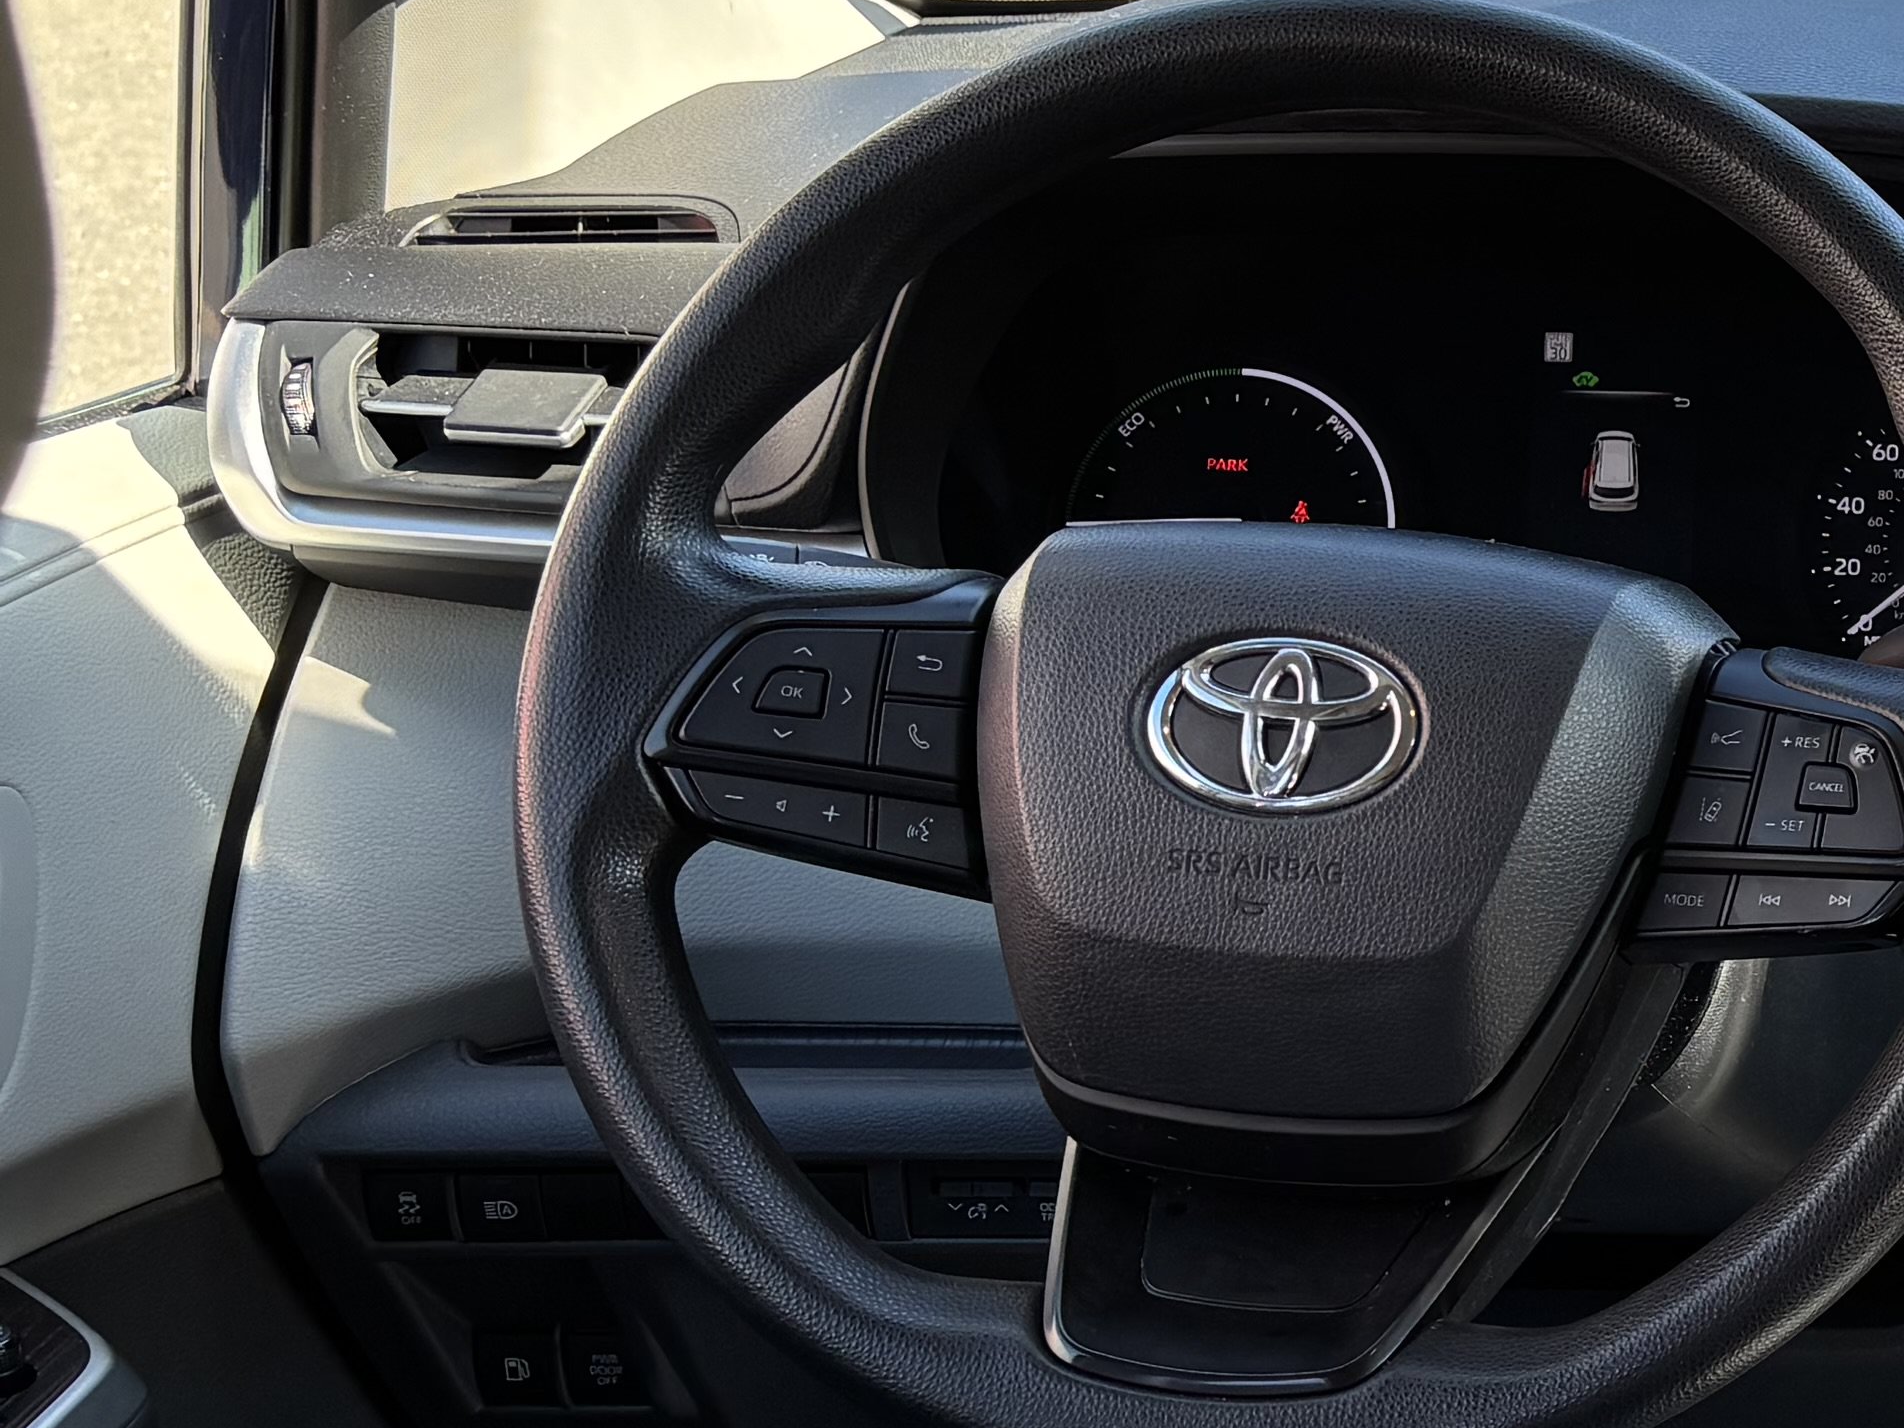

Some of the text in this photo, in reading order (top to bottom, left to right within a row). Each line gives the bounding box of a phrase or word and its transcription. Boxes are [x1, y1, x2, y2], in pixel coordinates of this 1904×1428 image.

[1118, 411, 1147, 438] ECO
[1323, 413, 1355, 446] PWR
[1872, 444, 1900, 462] 60
[1206, 457, 1249, 473] PARK
[1877, 489, 1894, 500] 80
[1836, 496, 1865, 514] 40
[1867, 516, 1884, 527] 60
[1864, 544, 1881, 555] 40
[1833, 557, 1861, 576] 20
[1870, 572, 1887, 584] 20
[780, 683, 804, 699] OK
[1808, 781, 1845, 793] CANCEL
[1168, 847, 1344, 885] SRS AIRBAG
[1663, 893, 1705, 908] MODE
[399, 1215, 423, 1226] OFF
